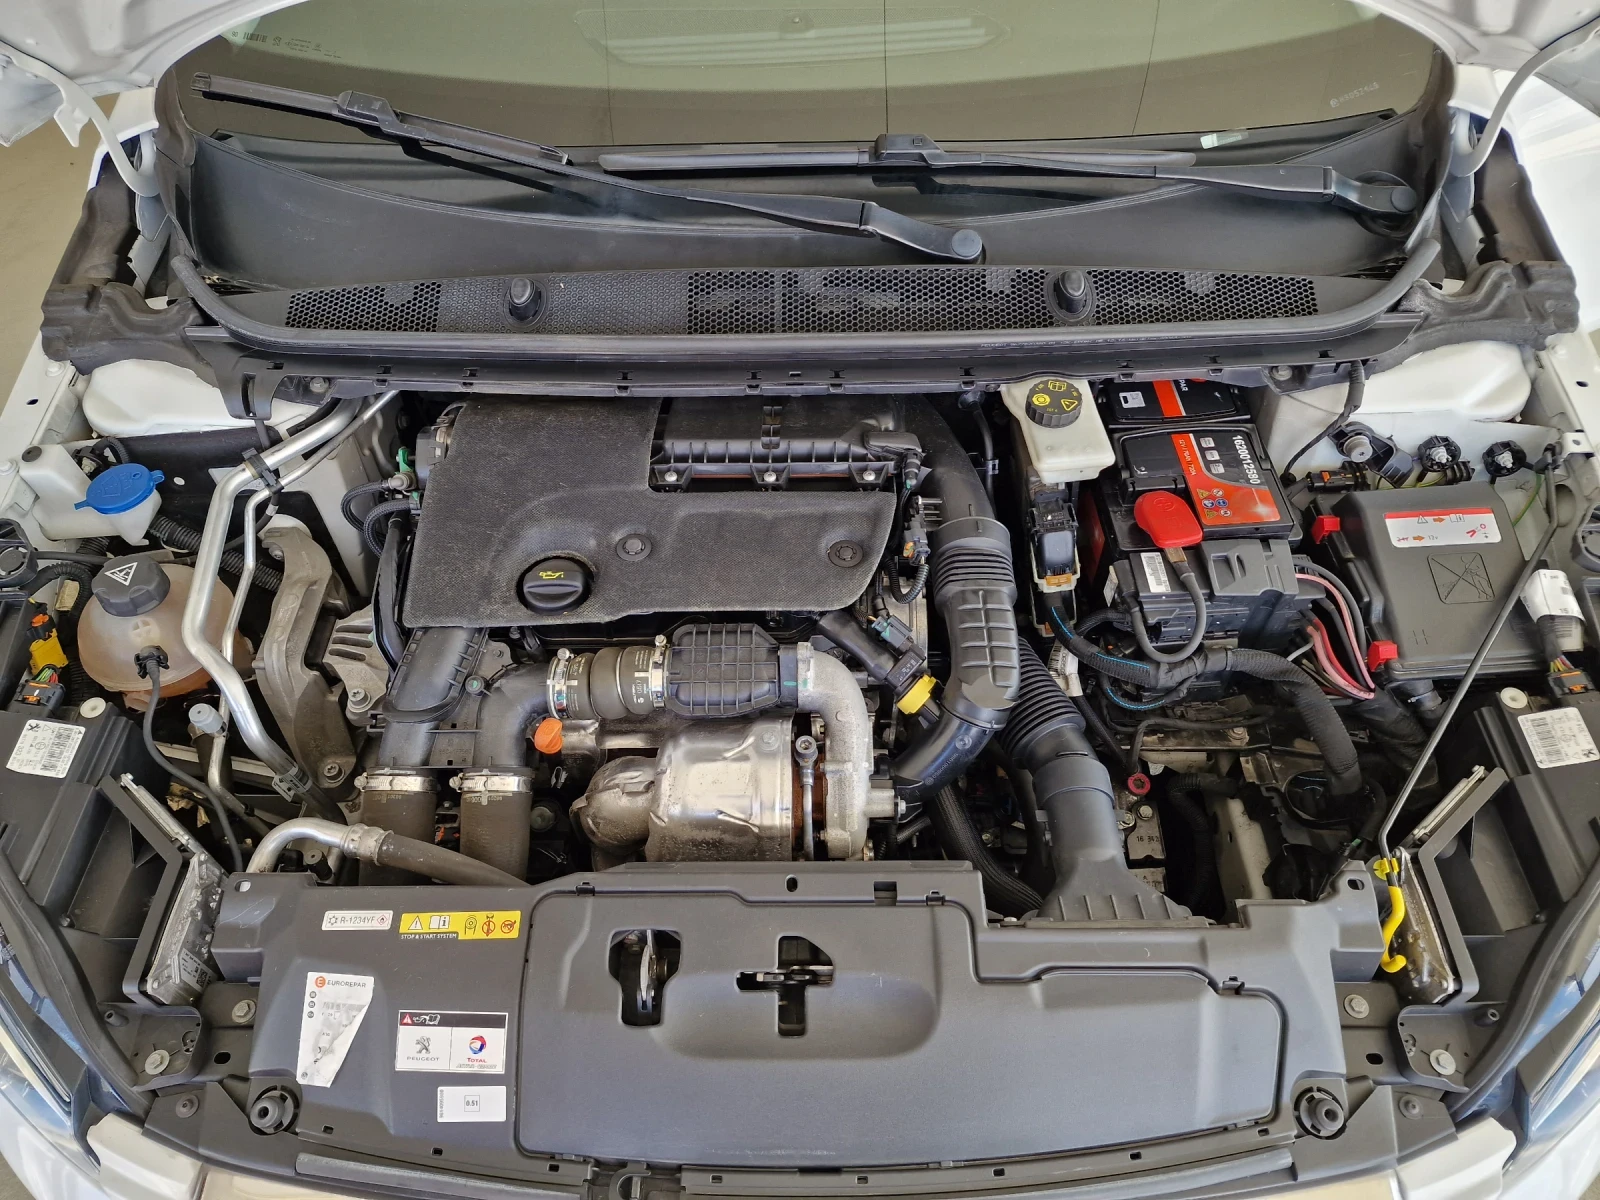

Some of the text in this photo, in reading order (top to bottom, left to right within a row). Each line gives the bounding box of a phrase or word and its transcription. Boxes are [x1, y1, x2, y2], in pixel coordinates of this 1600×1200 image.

[1232, 434, 1261, 485] 1620012580
[339, 915, 376, 925] R-1234YF
[327, 980, 367, 989] EUROREPAR
